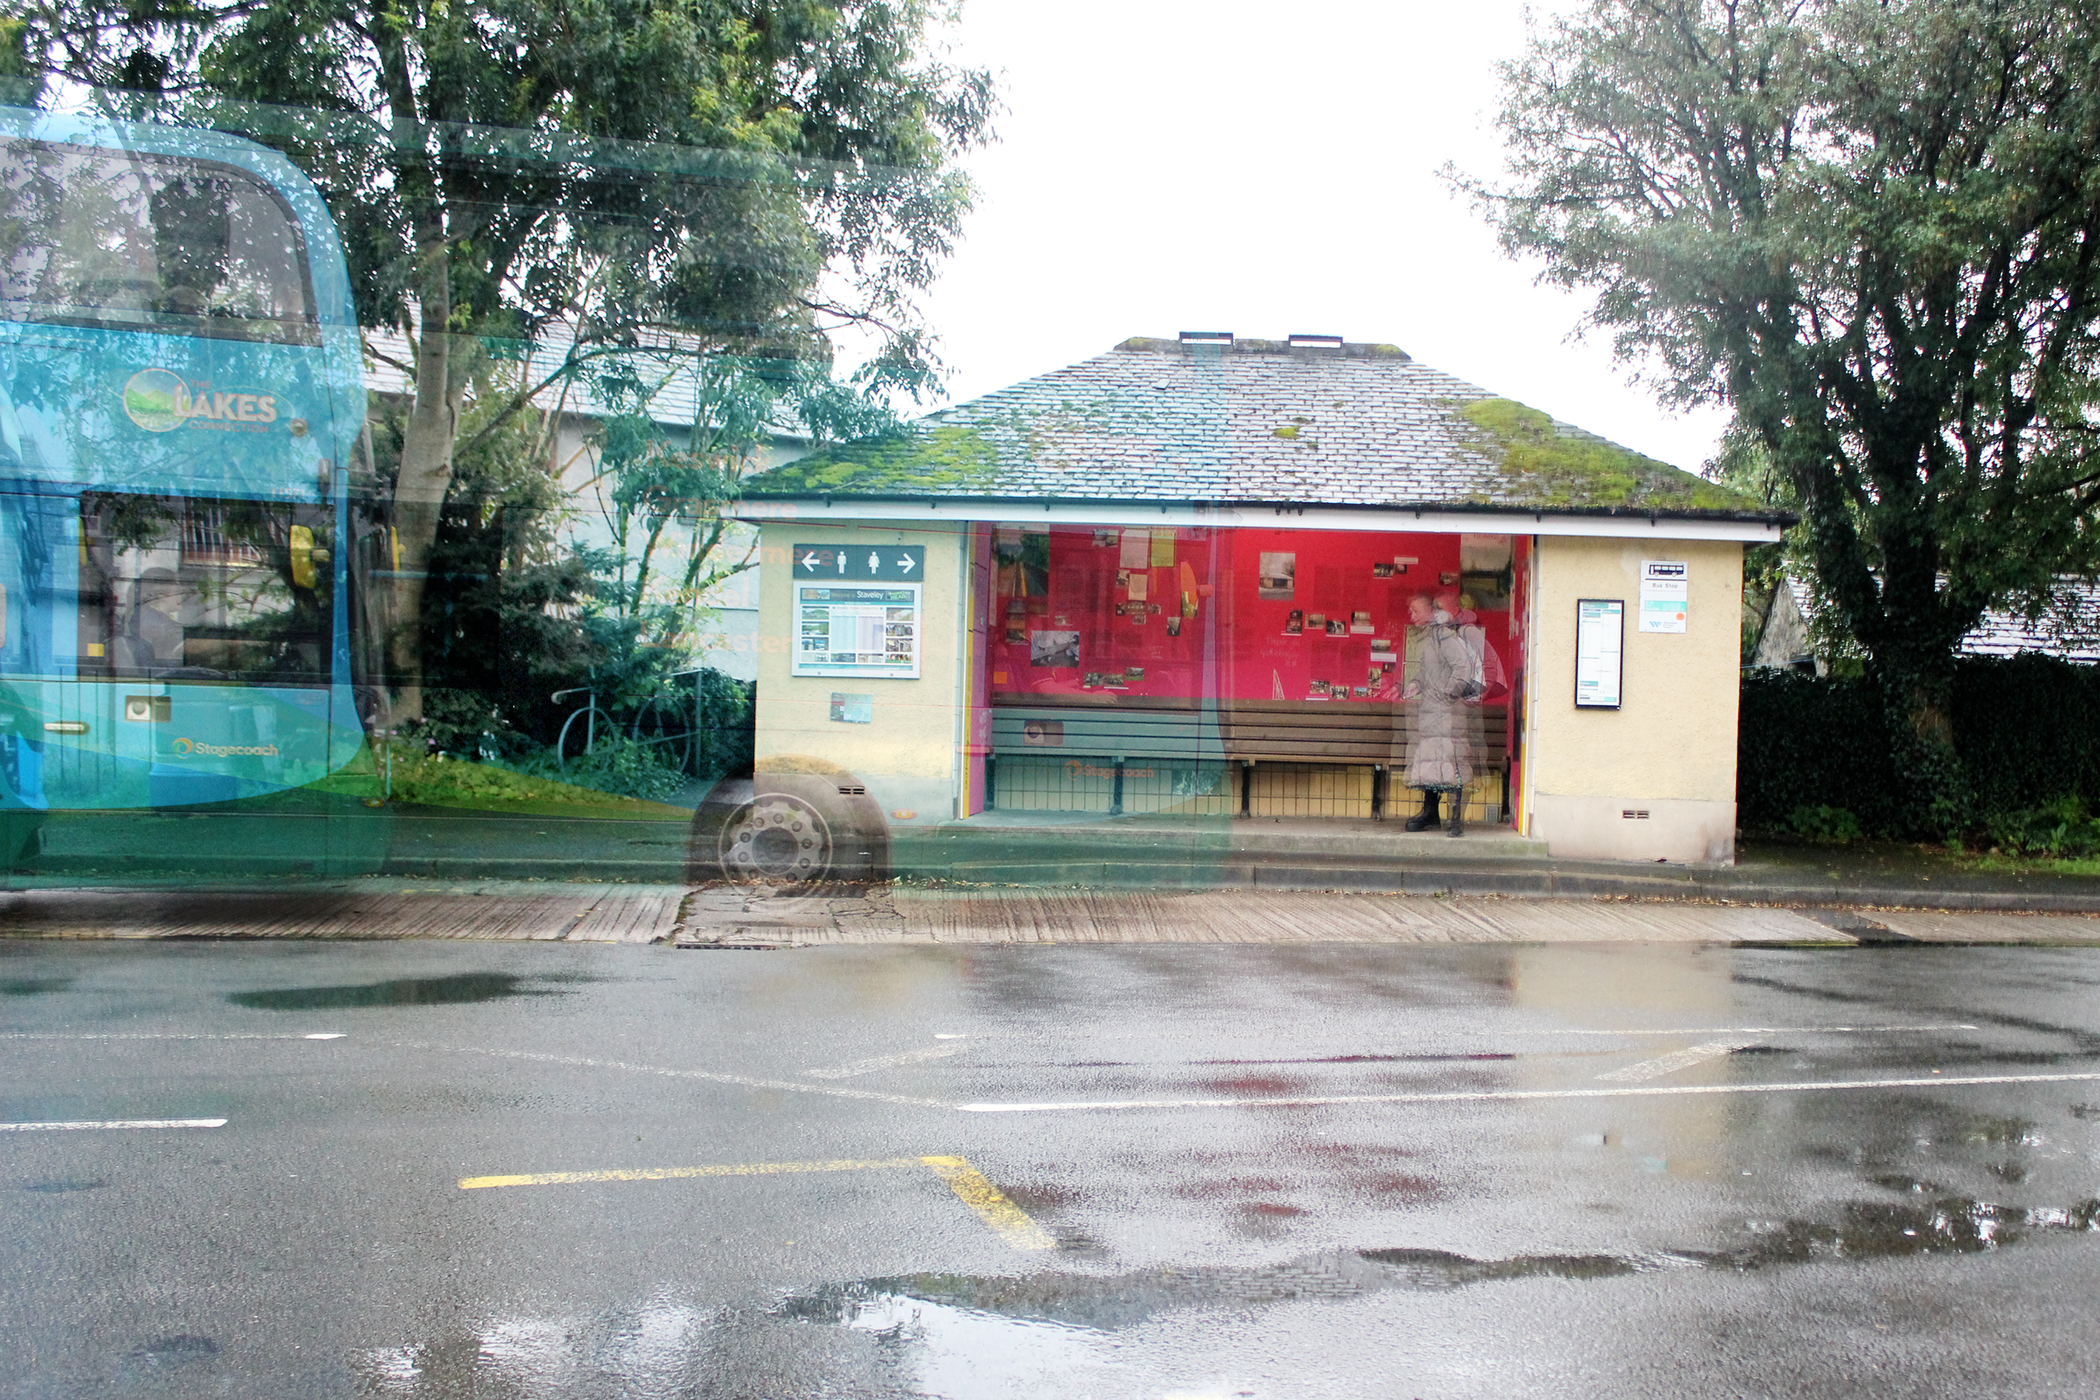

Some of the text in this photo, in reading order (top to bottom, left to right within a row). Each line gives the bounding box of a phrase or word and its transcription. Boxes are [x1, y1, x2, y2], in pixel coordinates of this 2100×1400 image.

[191, 379, 211, 389] THE
[173, 383, 278, 423] LAKES
[189, 421, 269, 433] CONNECTION
[644, 438, 772, 475] Keswick
[643, 484, 799, 520] Grasmere
[856, 590, 884, 600] Staveley
[195, 742, 279, 757] Stagecoach
[1083, 764, 1155, 780] Stagecoach
